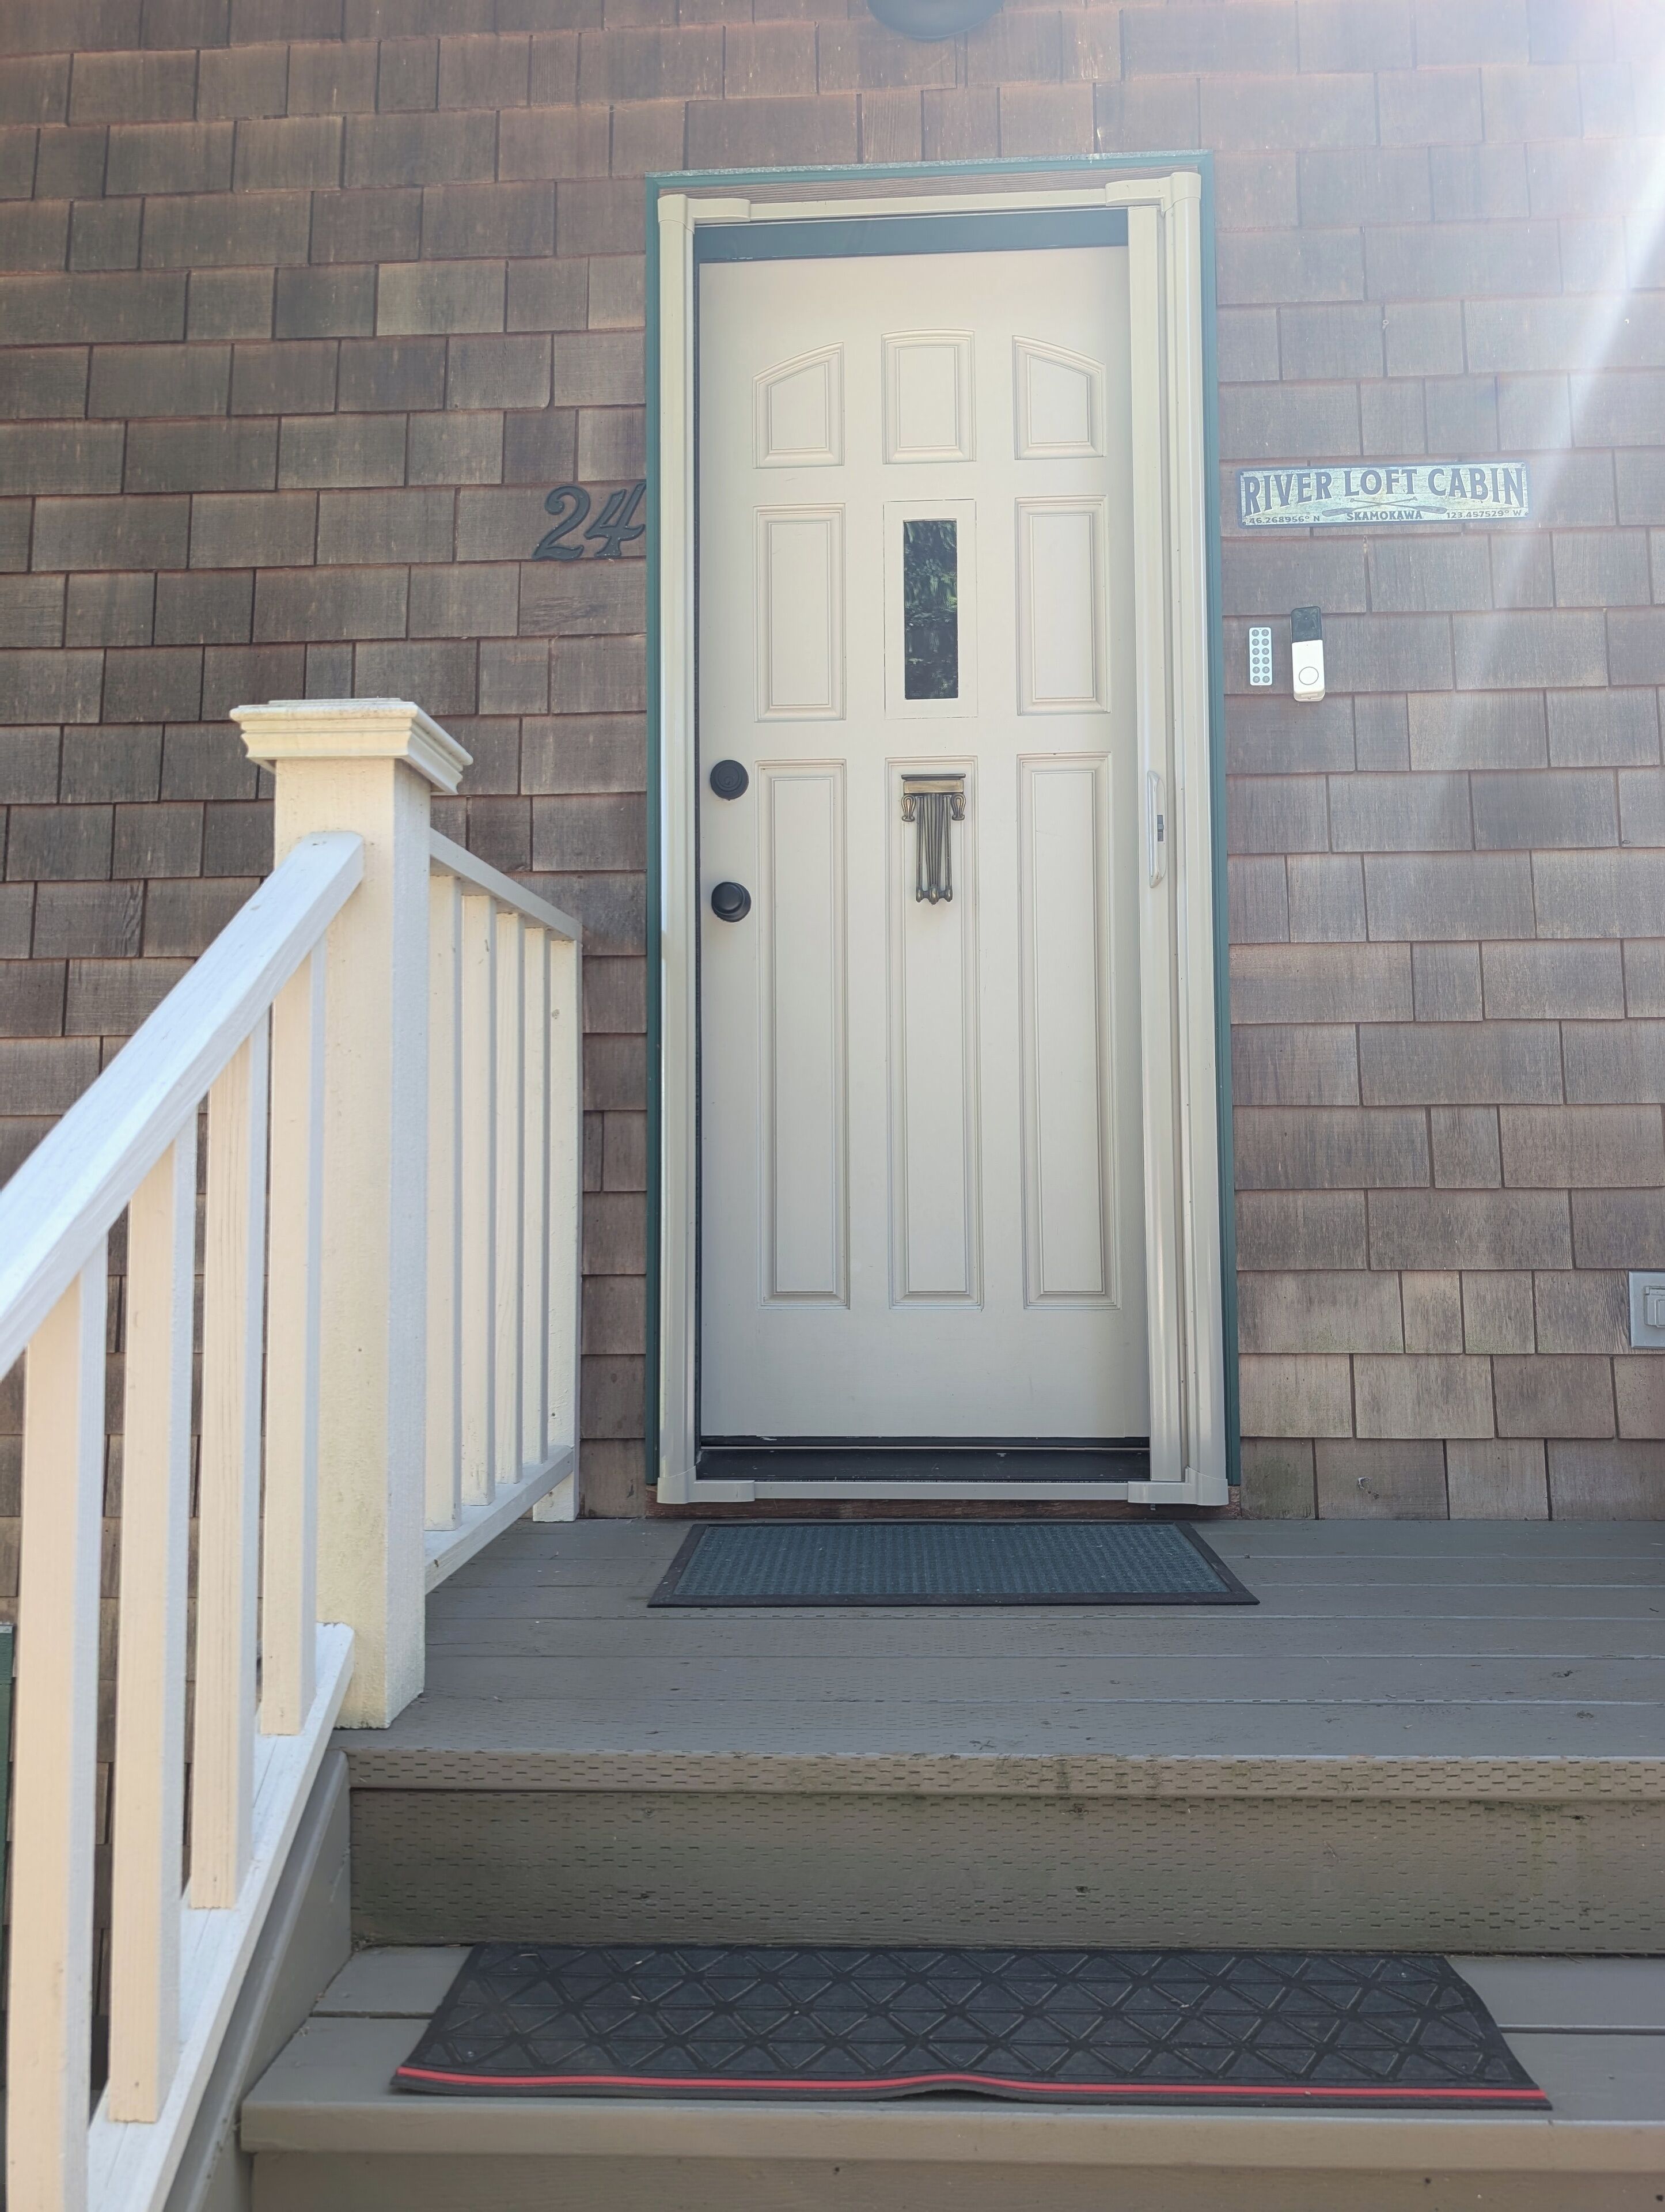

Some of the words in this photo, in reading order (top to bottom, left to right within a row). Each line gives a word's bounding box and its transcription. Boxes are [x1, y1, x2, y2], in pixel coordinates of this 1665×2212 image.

[1243, 472, 1332, 517] RIVER
[1344, 468, 1417, 497] LOFT
[1428, 468, 1526, 507] CABIN
[1347, 510, 1423, 521] SKAMOKAWA
[532, 483, 647, 562] 24
